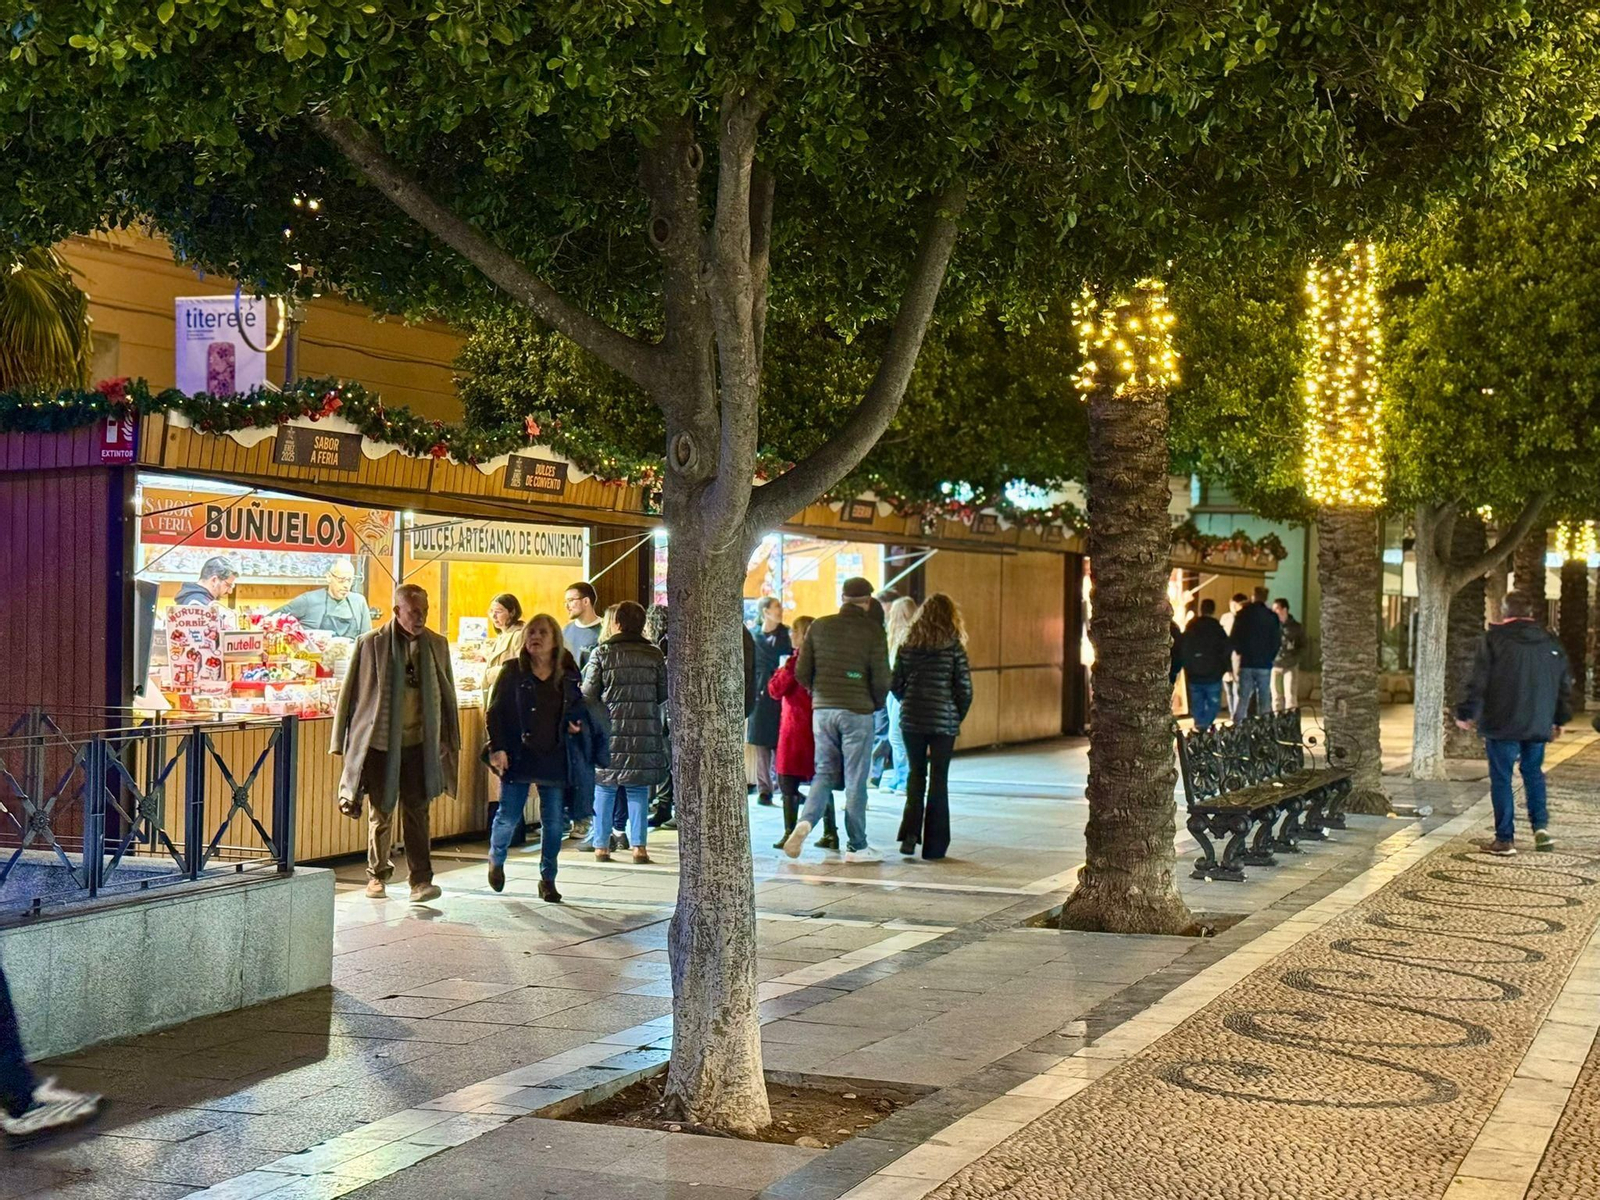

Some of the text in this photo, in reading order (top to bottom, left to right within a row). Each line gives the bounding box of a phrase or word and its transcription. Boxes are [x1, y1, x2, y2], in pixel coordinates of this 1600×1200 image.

[314, 436, 340, 451] SABOR
[101, 449, 134, 458] EXTINTOR
[310, 450, 339, 466] A FERIA
[525, 475, 562, 490] DE CONVENTO
[145, 497, 194, 517] SABOR
[159, 517, 193, 532] FERIA
[203, 500, 347, 547] BUÑUELOS
[413, 523, 584, 558] DULCES ARTESANOS DE CONVENTO
[227, 637, 261, 652] nutella
